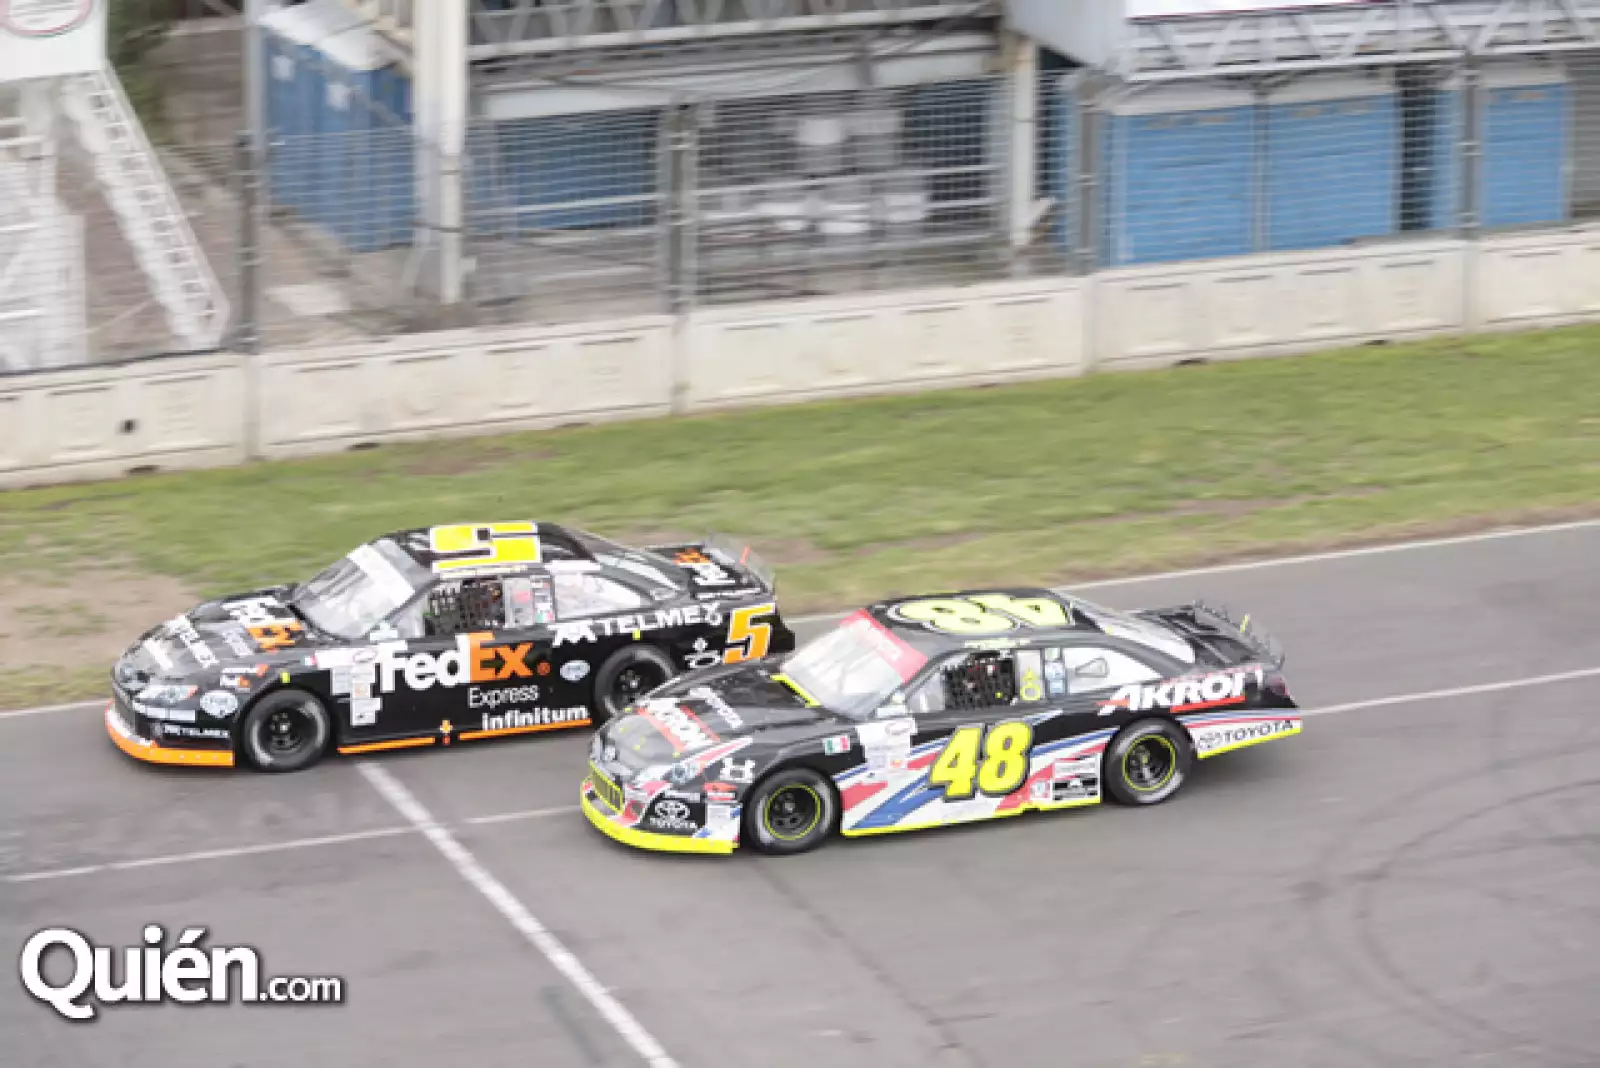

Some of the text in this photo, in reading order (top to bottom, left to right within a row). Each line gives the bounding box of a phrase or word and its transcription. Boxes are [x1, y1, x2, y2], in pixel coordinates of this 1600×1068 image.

[430, 521, 542, 572] 5
[602, 603, 723, 637] TELMEX
[723, 603, 776, 664] 5
[889, 593, 1076, 635] 48
[374, 629, 534, 692] FedEx
[468, 684, 540, 708] Express
[481, 705, 590, 732] infinitum
[1222, 718, 1294, 743] TOYOTA
[929, 721, 1033, 800] 48
